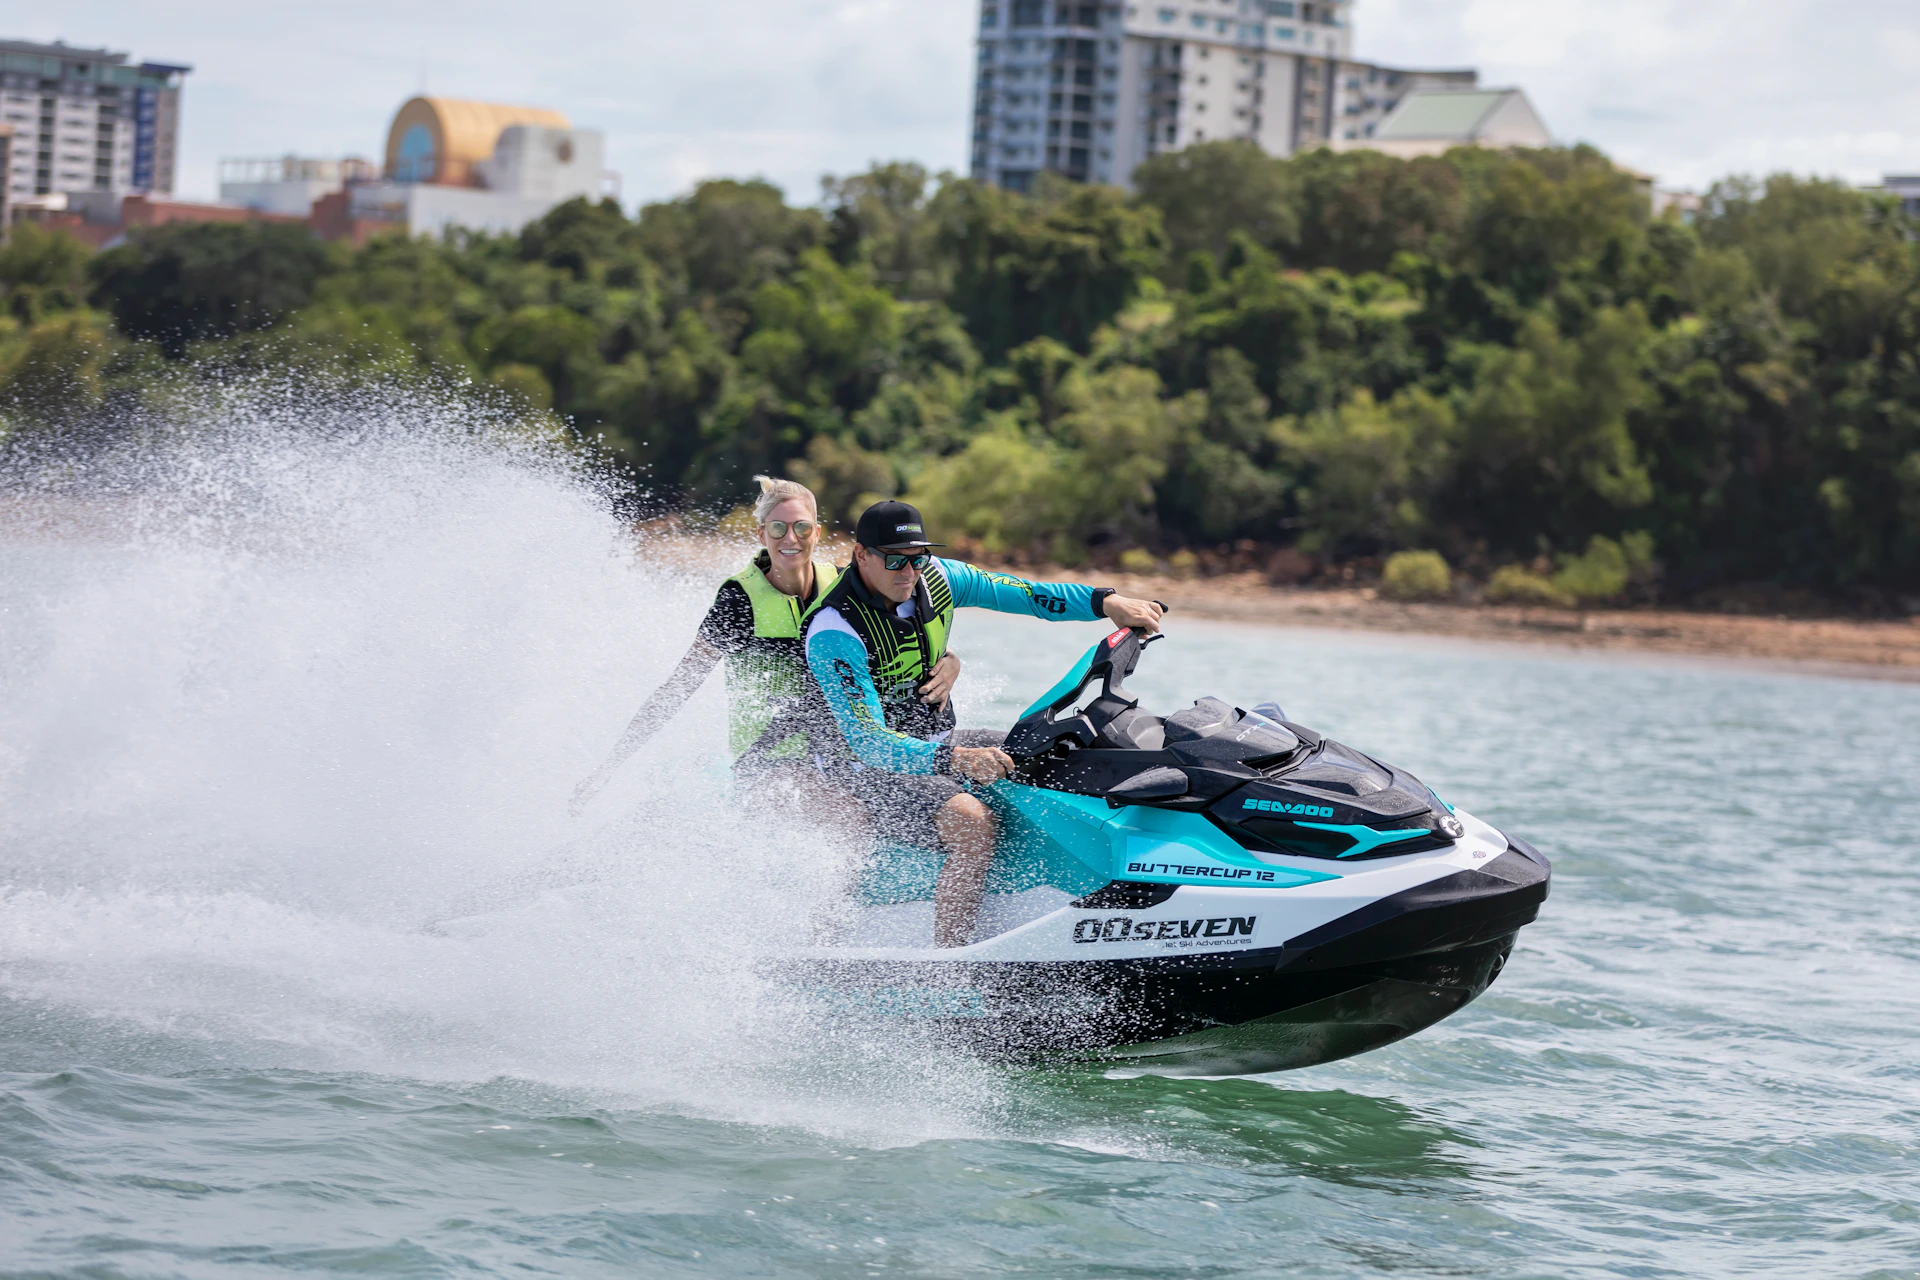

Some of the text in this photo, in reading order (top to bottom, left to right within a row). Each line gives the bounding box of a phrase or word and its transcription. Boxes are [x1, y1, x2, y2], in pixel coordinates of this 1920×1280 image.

[1127, 862, 1275, 882] BUTTERCUP 12
[1162, 938, 1252, 949] Jet Ski Adventures
